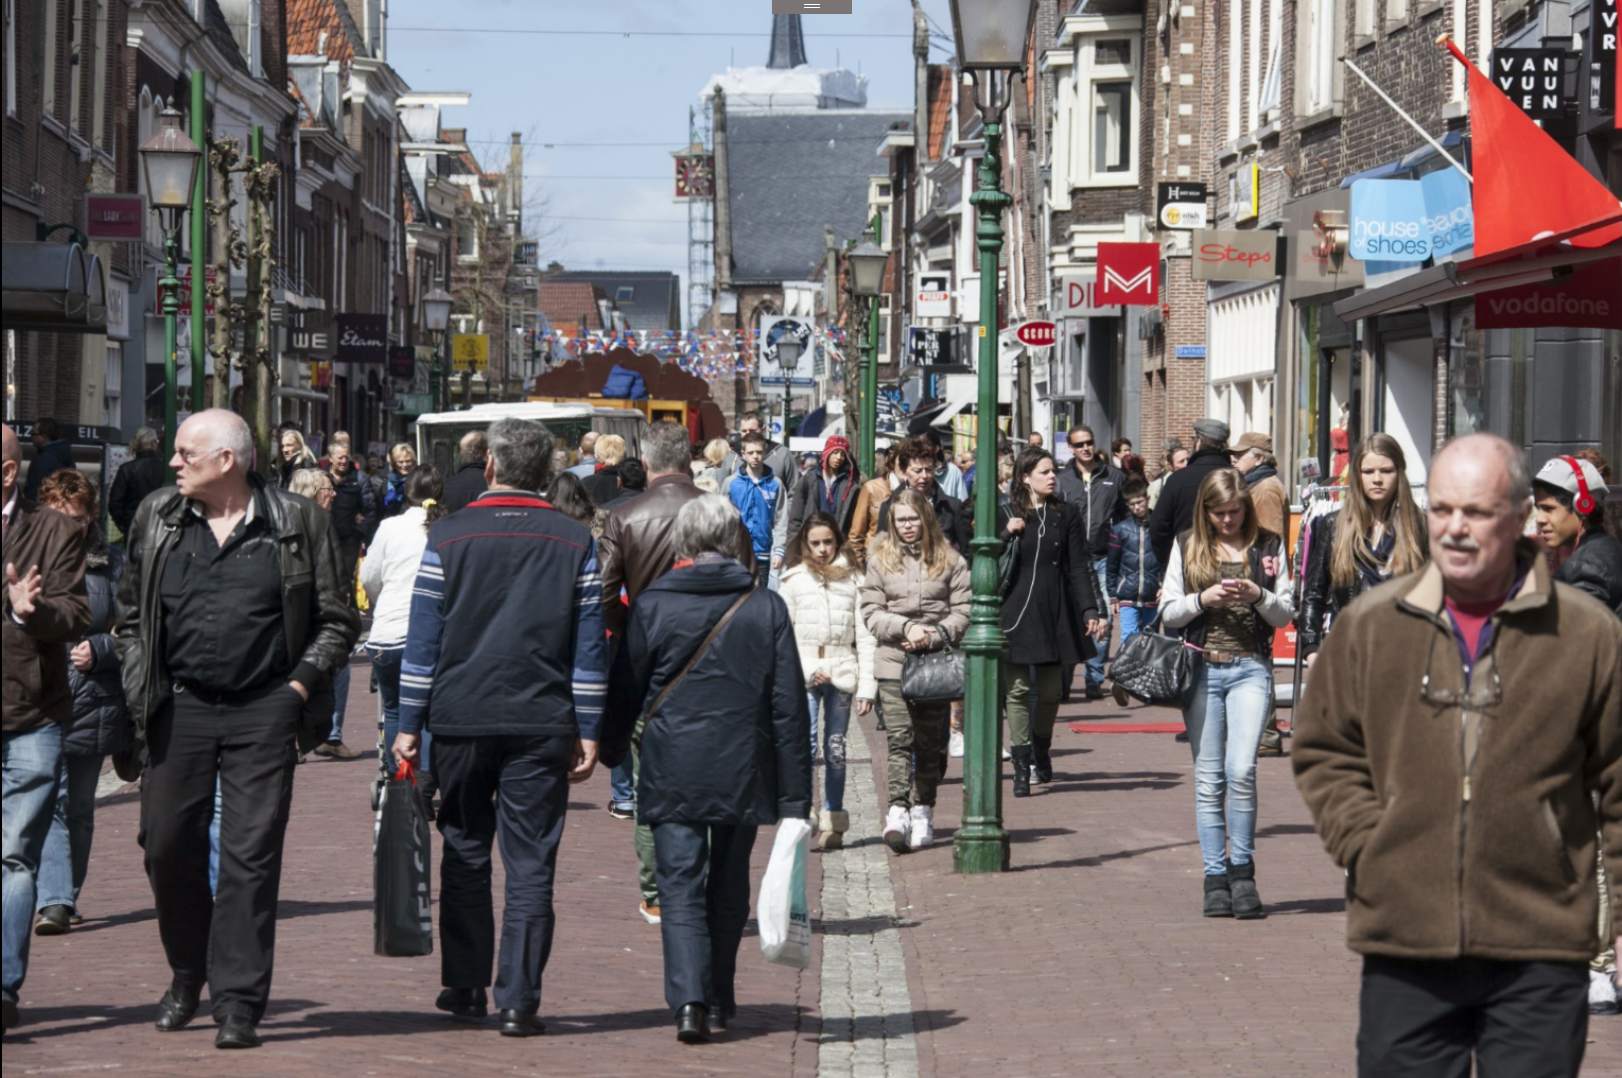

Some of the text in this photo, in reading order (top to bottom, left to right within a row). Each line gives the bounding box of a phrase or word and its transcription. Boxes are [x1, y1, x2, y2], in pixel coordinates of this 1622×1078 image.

[1501, 57, 1559, 72] VAN
[1500, 76, 1558, 91] VUU
[1506, 95, 1558, 110] EN
[1355, 216, 1419, 237] house
[1367, 235, 1428, 255] shoes
[1199, 243, 1271, 268] Steps
[1488, 291, 1609, 316] vodafone
[293, 333, 328, 349] WE
